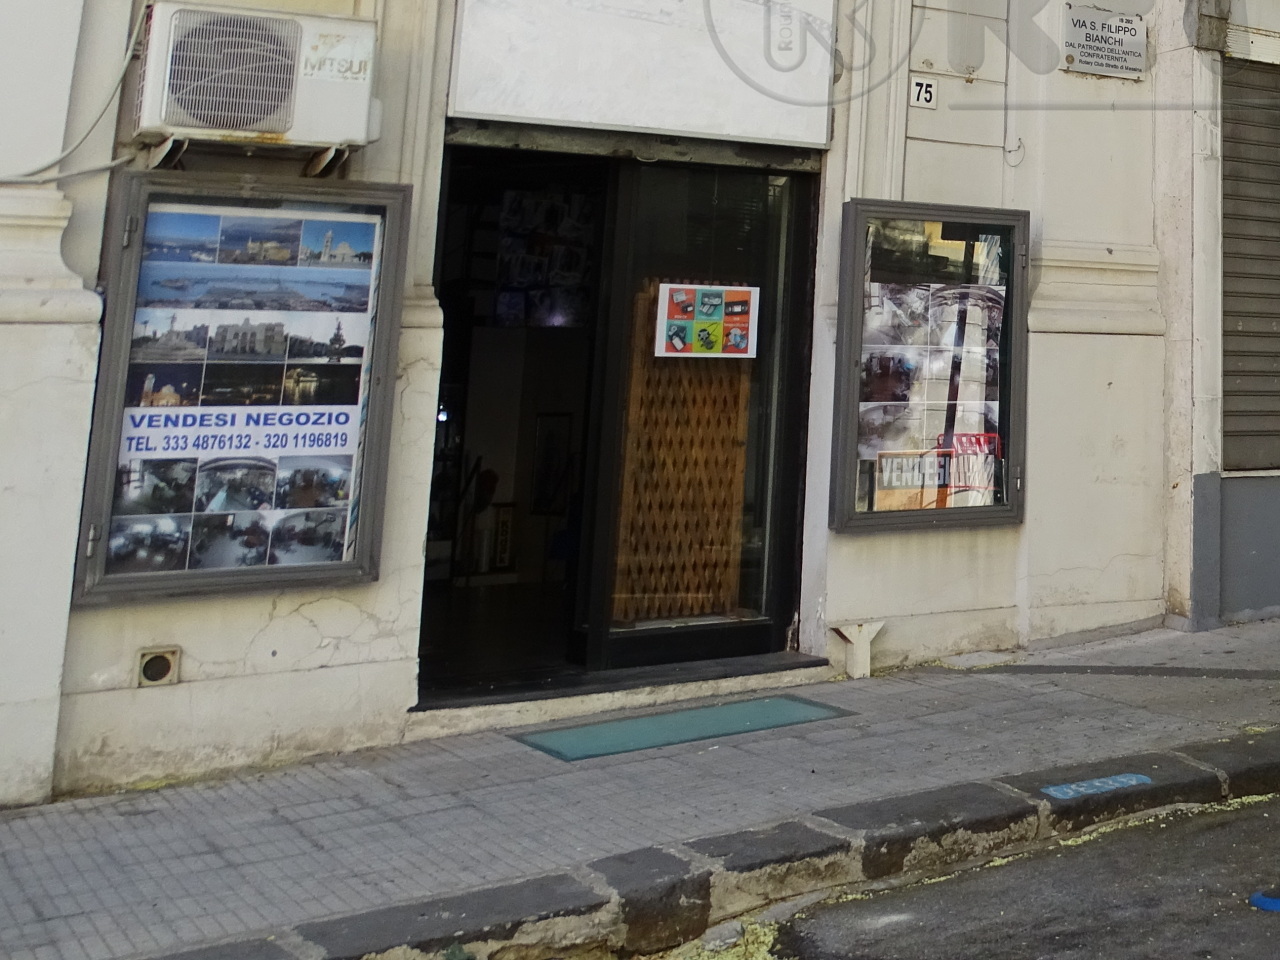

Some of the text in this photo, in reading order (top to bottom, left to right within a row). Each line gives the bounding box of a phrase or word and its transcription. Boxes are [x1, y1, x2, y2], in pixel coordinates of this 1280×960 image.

[1071, 18, 1137, 37] VIA S. FILIPPO
[1085, 32, 1123, 47] BIANCHI
[1065, 41, 1142, 58] DAL PATRONO DELL'ANTICA
[1079, 51, 1127, 64] CONFRATERNITA
[915, 81, 933, 103] 75
[129, 412, 350, 428] VENDESI NEGOZIO
[126, 436, 157, 452] TEL.
[162, 435, 188, 451] 333
[192, 434, 251, 451] 4876132
[263, 433, 288, 449] 320
[292, 432, 348, 448] 1196819
